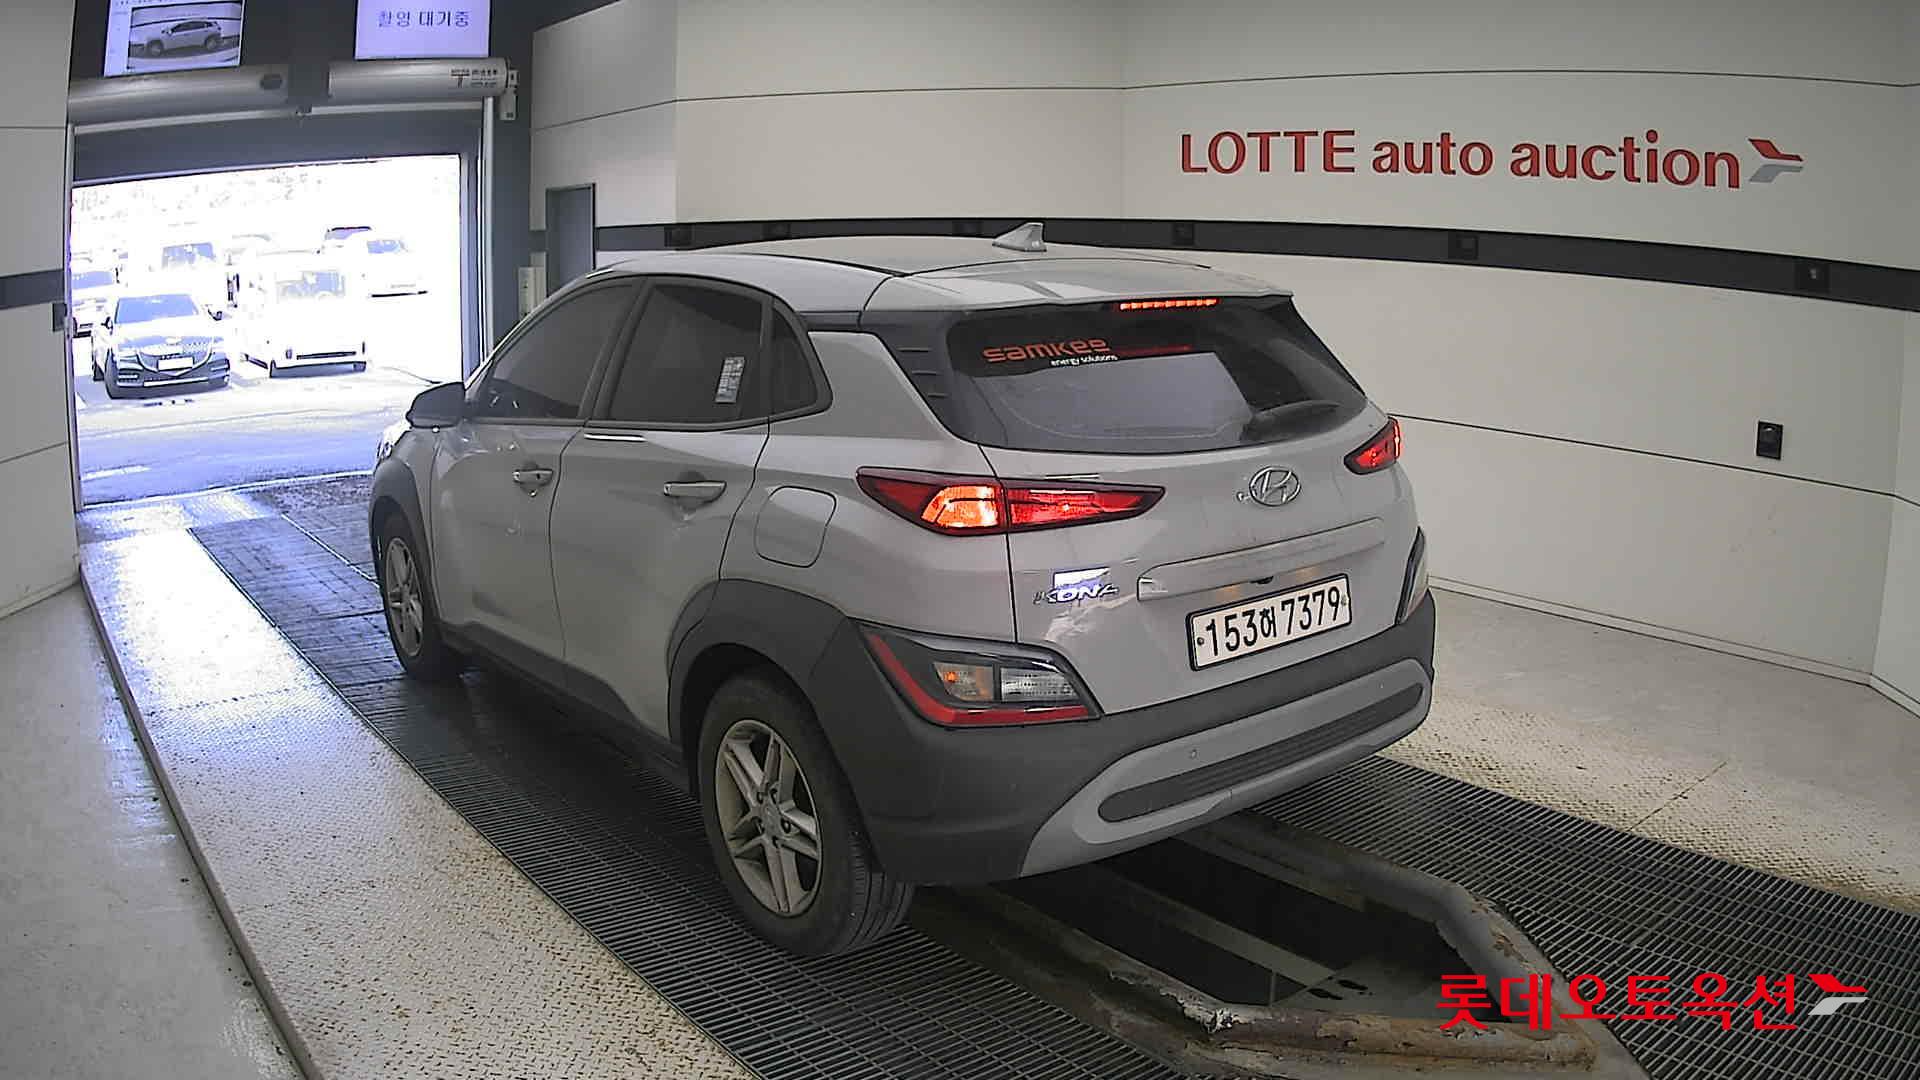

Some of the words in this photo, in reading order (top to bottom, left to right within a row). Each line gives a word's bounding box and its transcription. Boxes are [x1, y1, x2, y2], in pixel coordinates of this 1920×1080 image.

[418, 10, 470, 28] 대기중
[1181, 129, 1357, 174] LOTTE
[1373, 133, 1494, 175] auto
[1510, 129, 1741, 189] auction
[1050, 357, 1080, 367] energy
[1080, 354, 1119, 364] solutions
[1033, 583, 1119, 605] KONA
